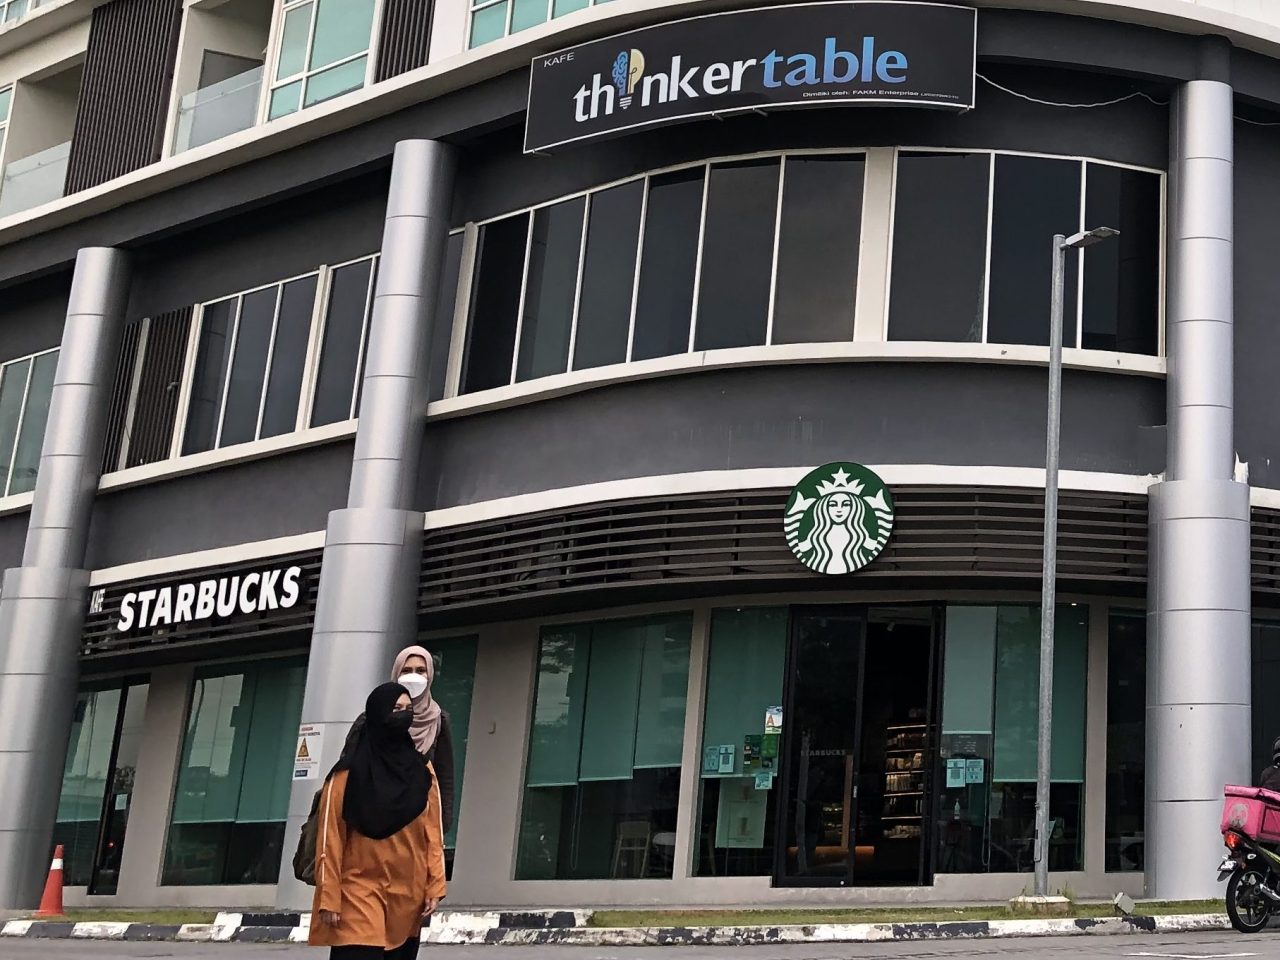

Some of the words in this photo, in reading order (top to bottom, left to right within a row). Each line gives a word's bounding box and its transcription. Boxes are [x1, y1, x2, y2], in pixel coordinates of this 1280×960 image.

[543, 52, 575, 68] KAFE
[878, 89, 919, 97] Enterprise
[116, 566, 302, 632] STARBUCKS
